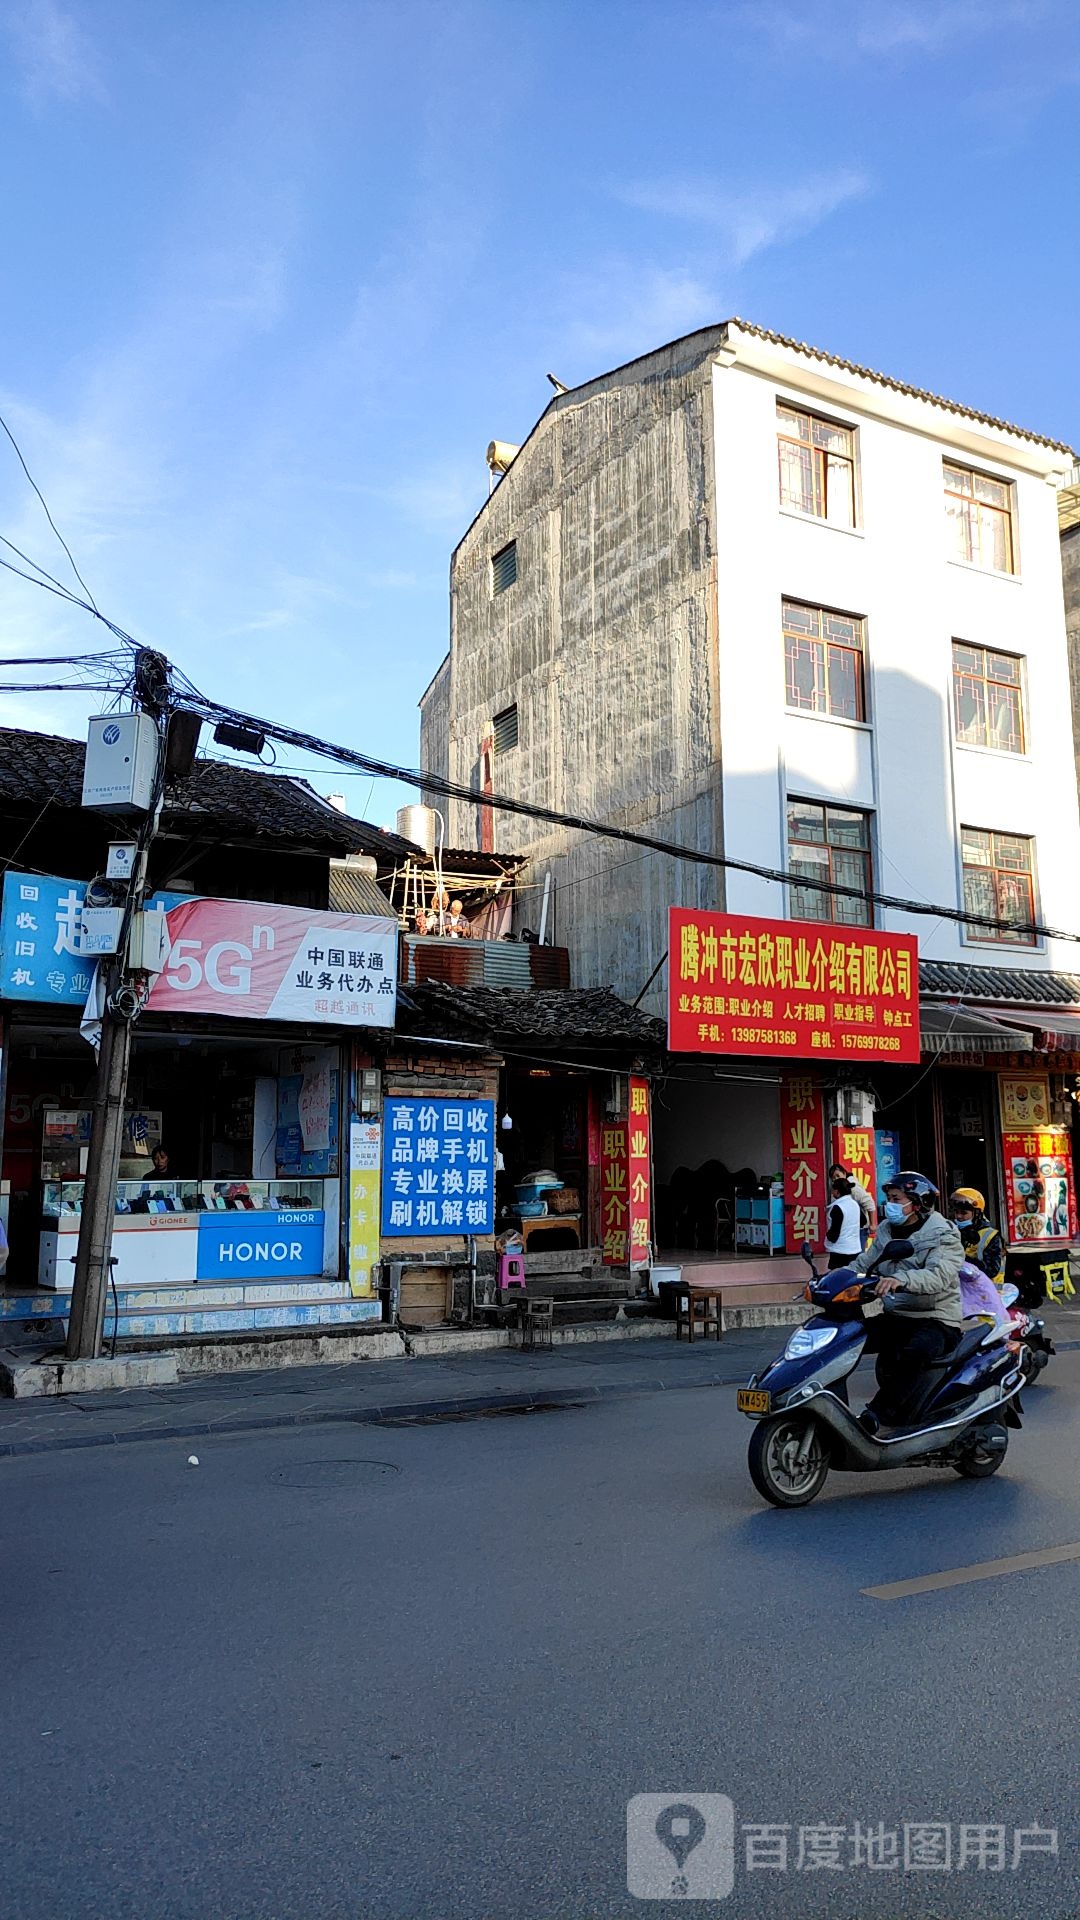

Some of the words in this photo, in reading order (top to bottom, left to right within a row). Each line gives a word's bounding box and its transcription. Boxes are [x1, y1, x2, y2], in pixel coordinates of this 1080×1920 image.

[10, 884, 39, 986] 回收旧机
[307, 946, 384, 971] 中国联通
[680, 924, 911, 1000] 腾冲市宏欣职业介绍有限公司
[296, 970, 395, 995] 业务代办点
[314, 1000, 377, 1017] 超越通讯
[782, 1002, 826, 1023] 人才招聘
[833, 1002, 875, 1023] 职业指导
[883, 1011, 913, 1028] 钟点工
[391, 1105, 489, 1134] 高价回收
[391, 1137, 489, 1164] 品牌手机
[788, 1076, 820, 1242] 职业介绍
[630, 1087, 648, 1247] 职业介绍
[391, 1168, 489, 1195] 专业换屏
[603, 1129, 626, 1260] 职业介绍
[277, 1214, 315, 1223] HONOR
[389, 1200, 488, 1226] 刷机解锁
[219, 1242, 303, 1262] HONOR
